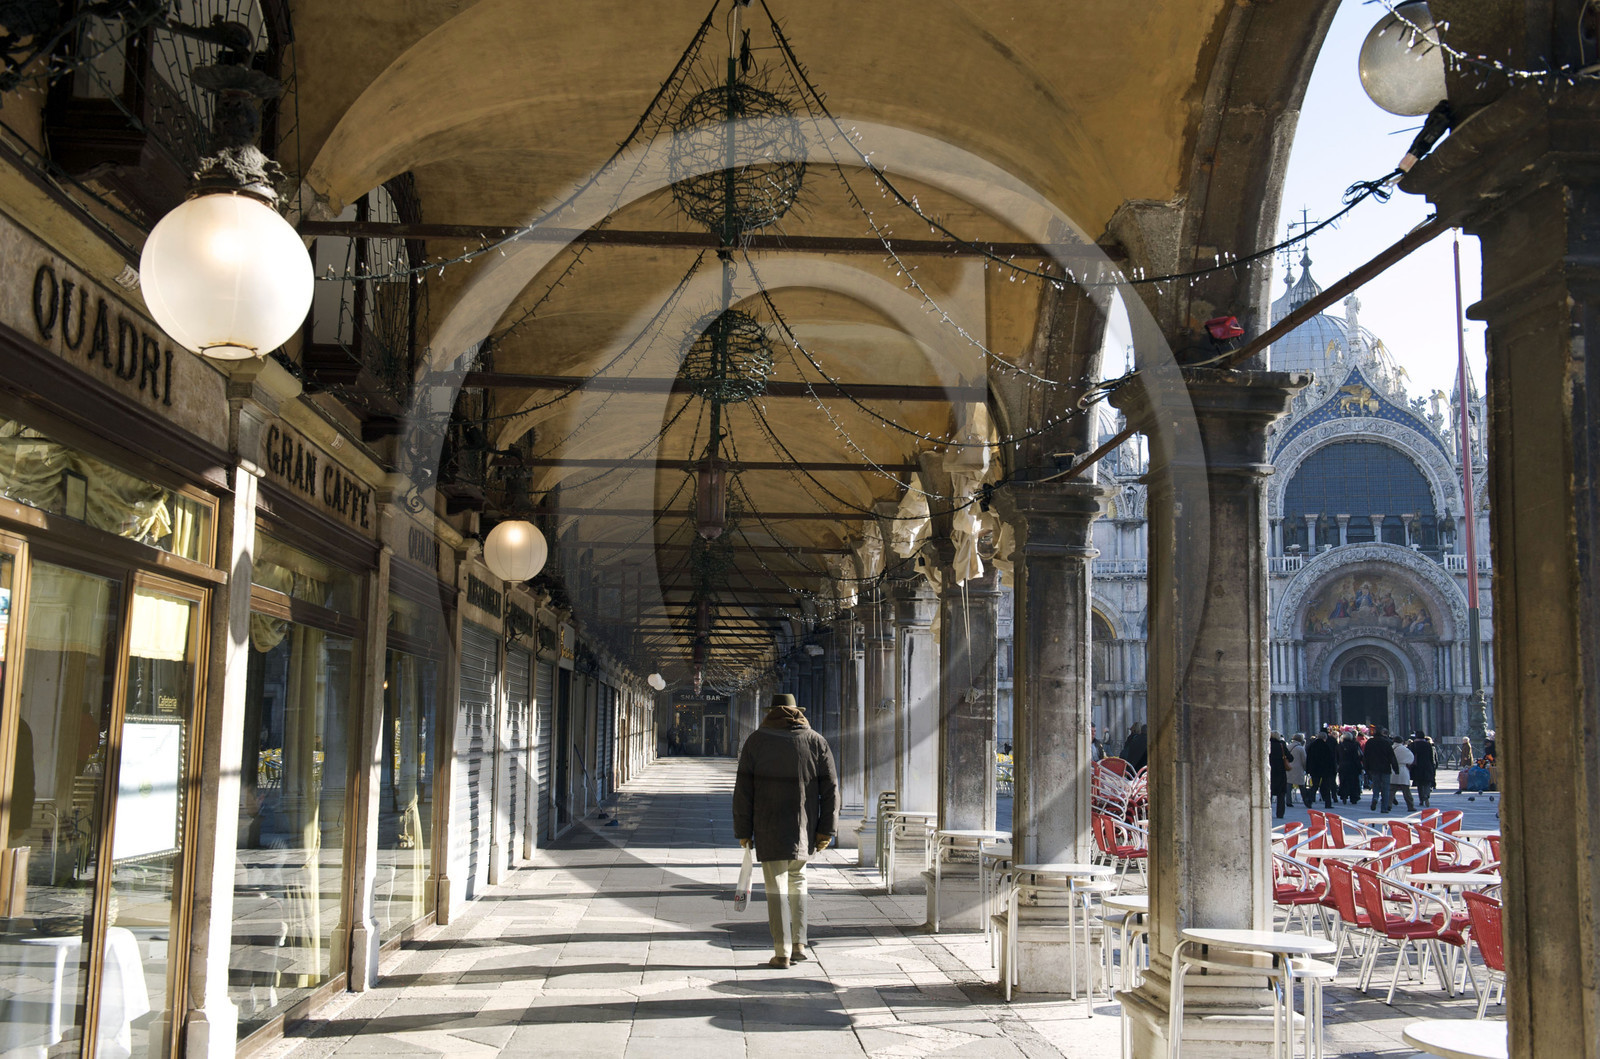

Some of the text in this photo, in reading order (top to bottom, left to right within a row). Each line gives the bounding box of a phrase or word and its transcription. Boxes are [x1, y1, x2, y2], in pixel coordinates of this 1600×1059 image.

[34, 264, 174, 407] QUADRI
[266, 424, 317, 497] GRAN
[680, 693, 721, 701] SNACK BAR
